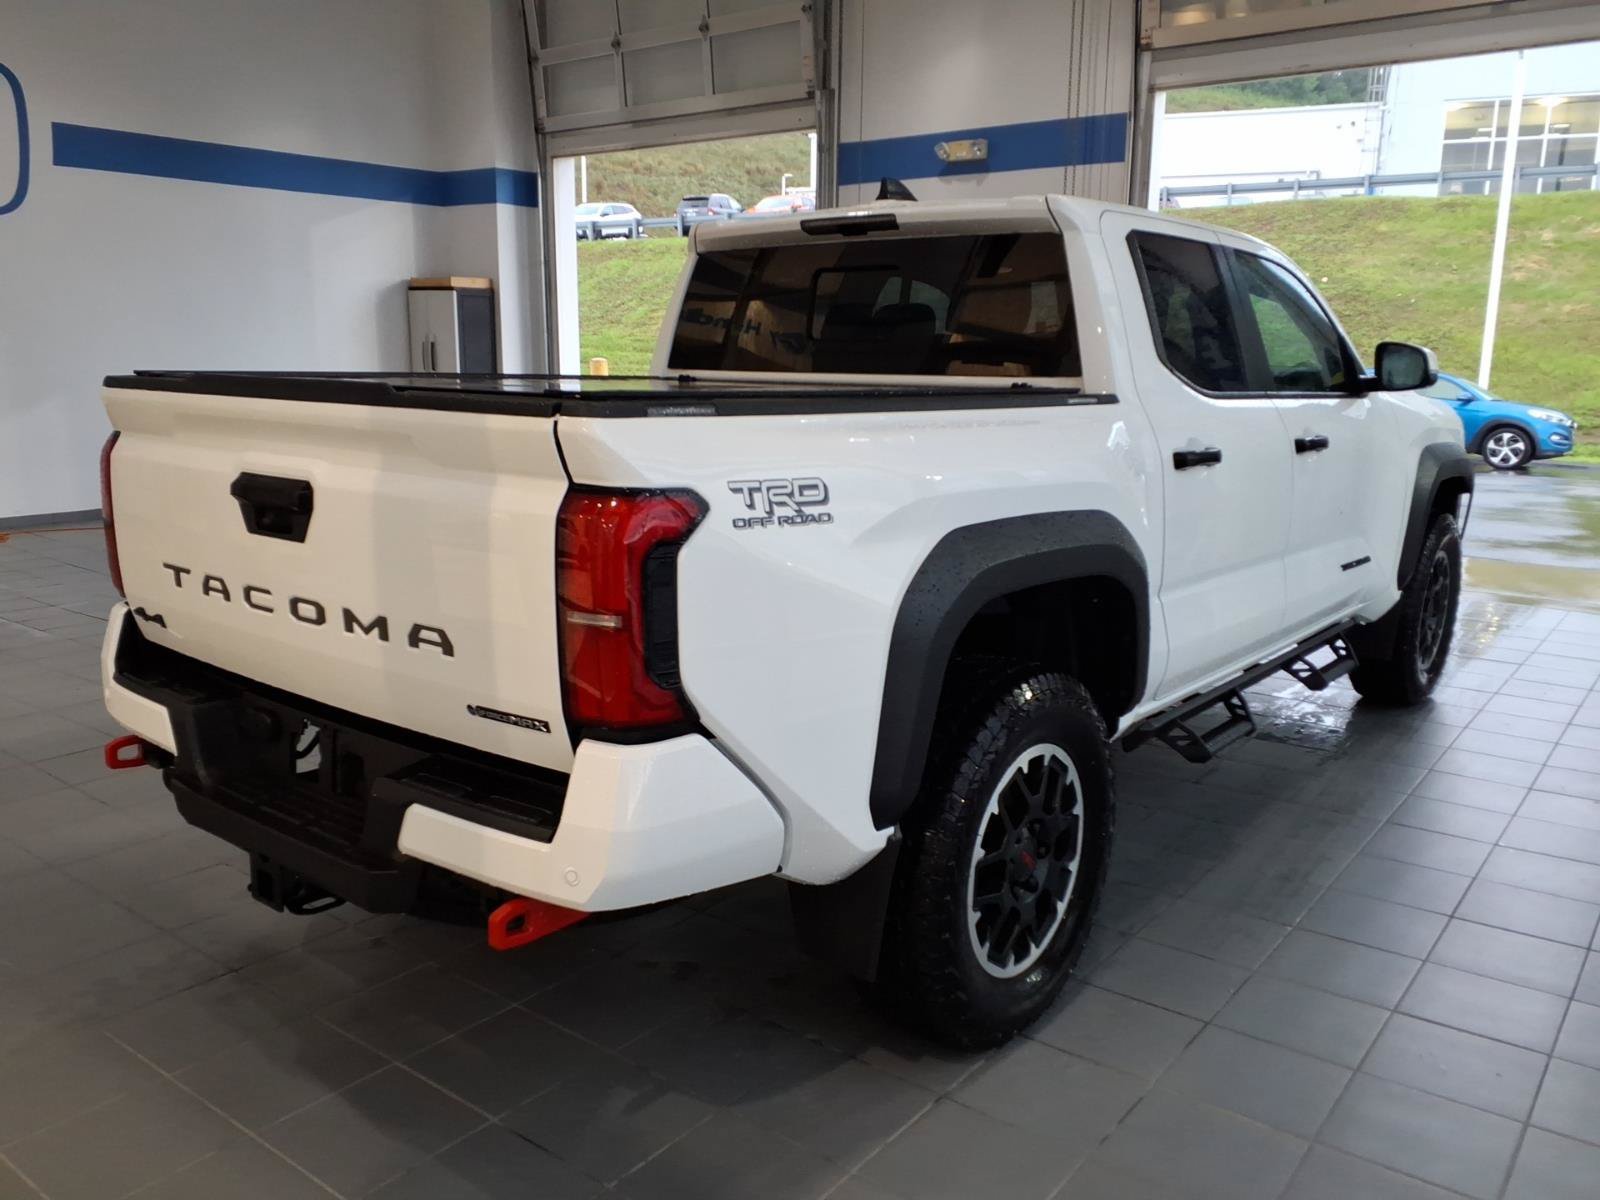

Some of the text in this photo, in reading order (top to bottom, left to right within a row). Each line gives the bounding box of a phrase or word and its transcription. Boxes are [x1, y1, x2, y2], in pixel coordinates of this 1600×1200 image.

[727, 477, 829, 515] TRD
[732, 512, 833, 529] OFF ROAD
[162, 561, 455, 658] TACOMA
